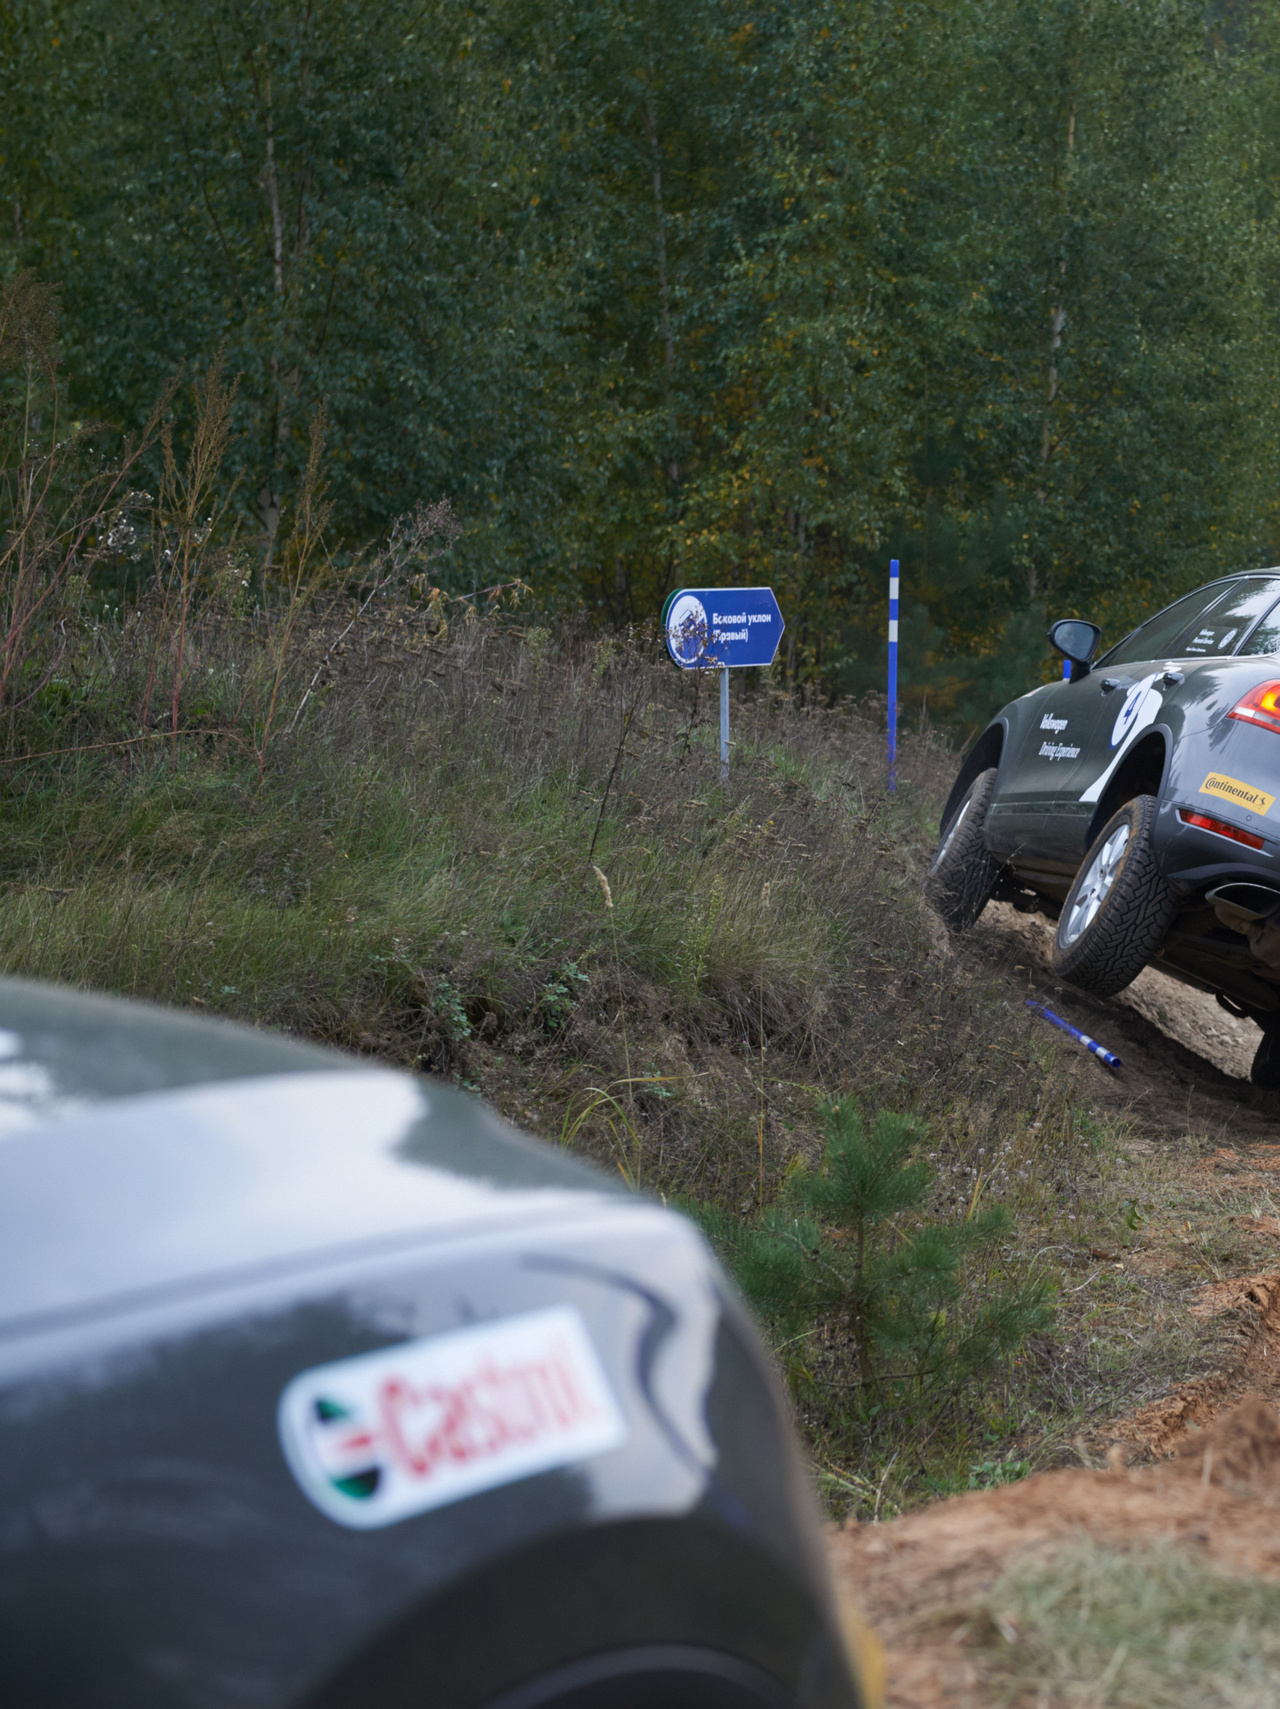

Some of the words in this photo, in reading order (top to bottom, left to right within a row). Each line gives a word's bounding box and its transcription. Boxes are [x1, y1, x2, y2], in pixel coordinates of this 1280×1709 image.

[712, 612, 747, 625] Боковой
[747, 613, 772, 626] уклон
[712, 628, 748, 643] (Правый)
[1205, 777, 1258, 804] Continental
